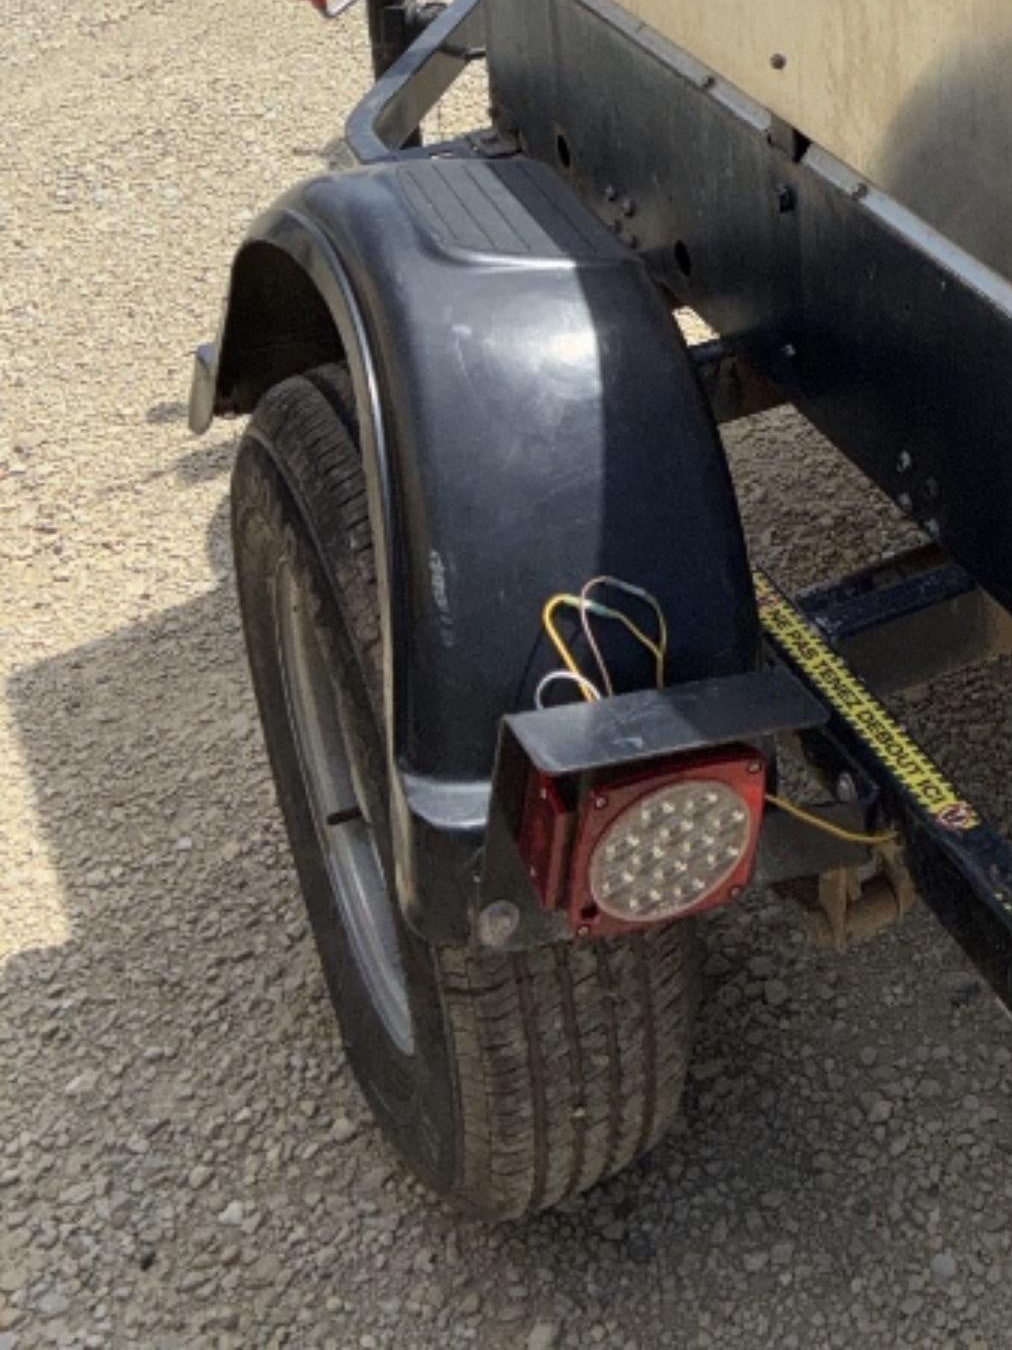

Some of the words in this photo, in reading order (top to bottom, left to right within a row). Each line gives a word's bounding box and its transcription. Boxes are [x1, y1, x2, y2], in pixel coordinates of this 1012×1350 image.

[788, 630, 819, 661] PAS
[811, 659, 861, 708] TENEZ
[856, 709, 926, 776] DEBOUT
